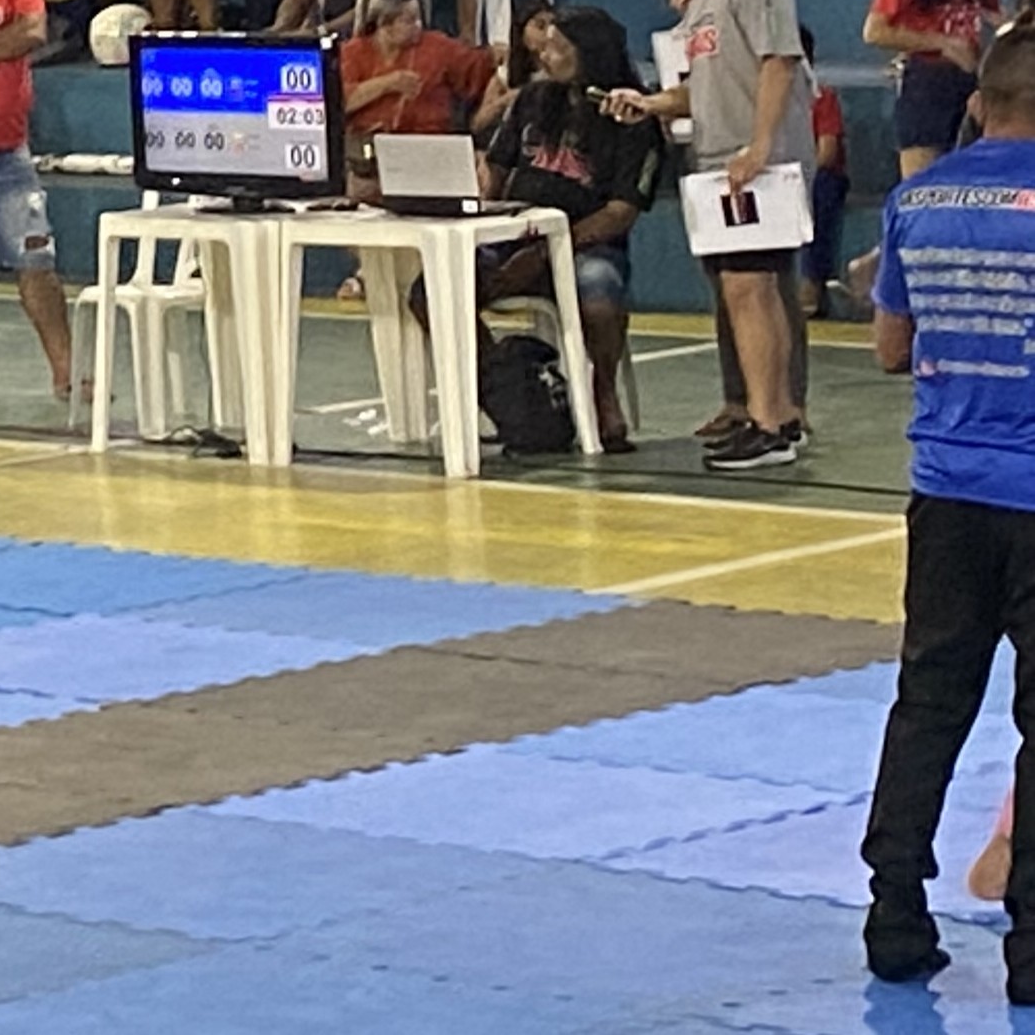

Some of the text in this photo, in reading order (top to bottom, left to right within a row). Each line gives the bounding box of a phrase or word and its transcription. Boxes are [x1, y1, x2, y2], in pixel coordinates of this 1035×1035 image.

[286, 68, 312, 90] 00
[276, 108, 325, 125] 02:03
[290, 145, 315, 167] 00
